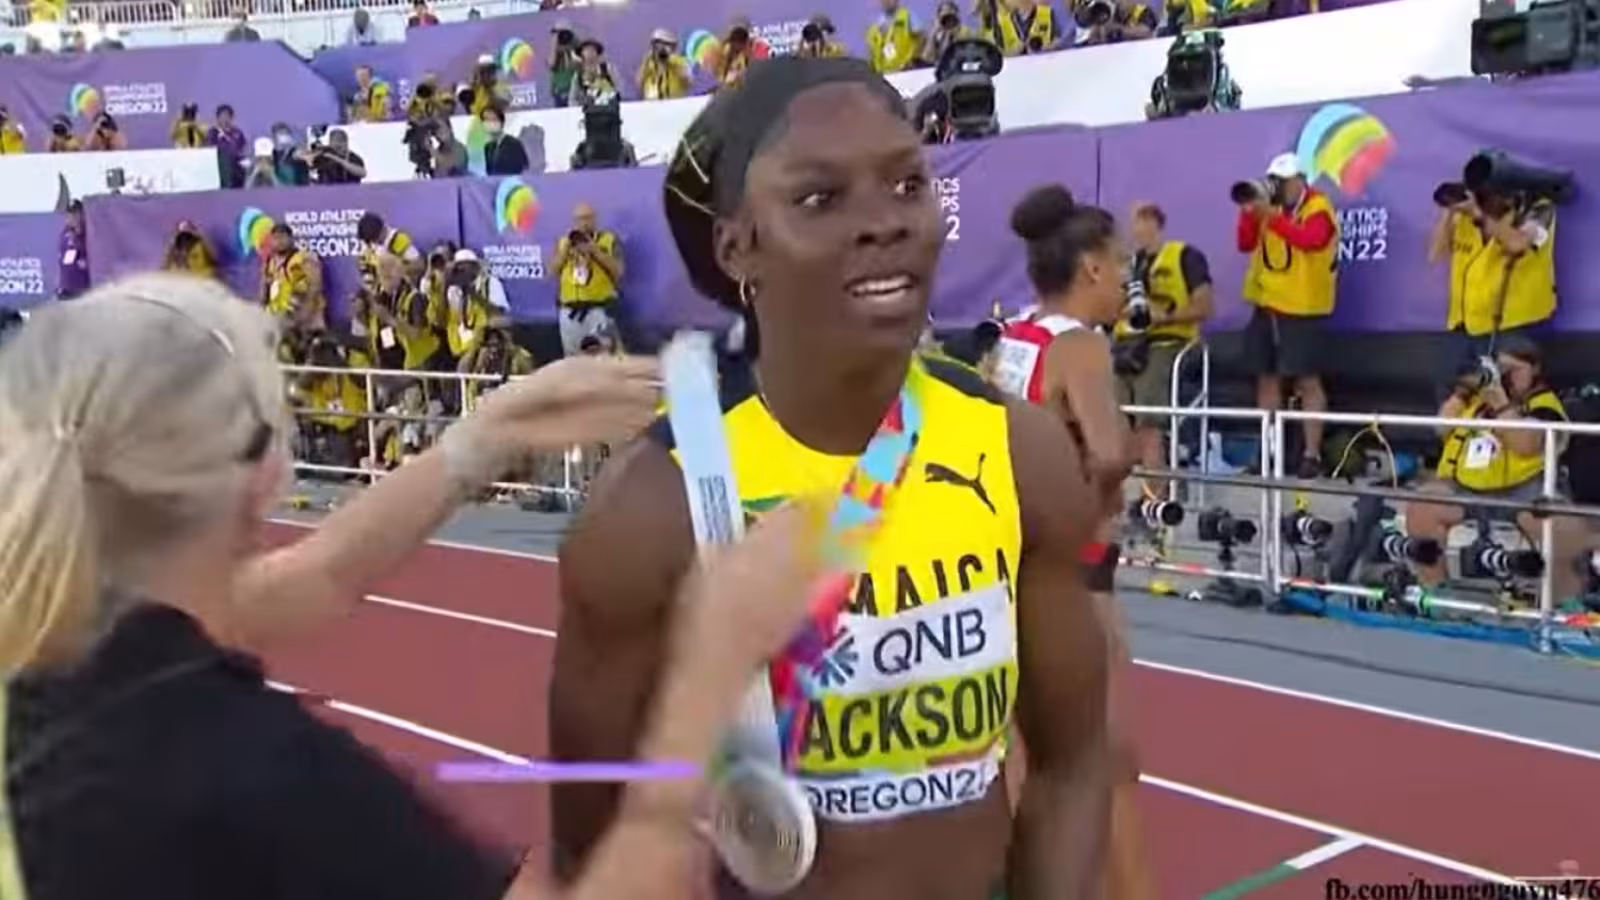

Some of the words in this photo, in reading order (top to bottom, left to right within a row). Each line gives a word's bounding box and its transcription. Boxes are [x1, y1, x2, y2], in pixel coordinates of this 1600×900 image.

[873, 608, 986, 676] QNB
[800, 667, 1007, 762] ACKSON
[806, 768, 985, 814] OREGON2
